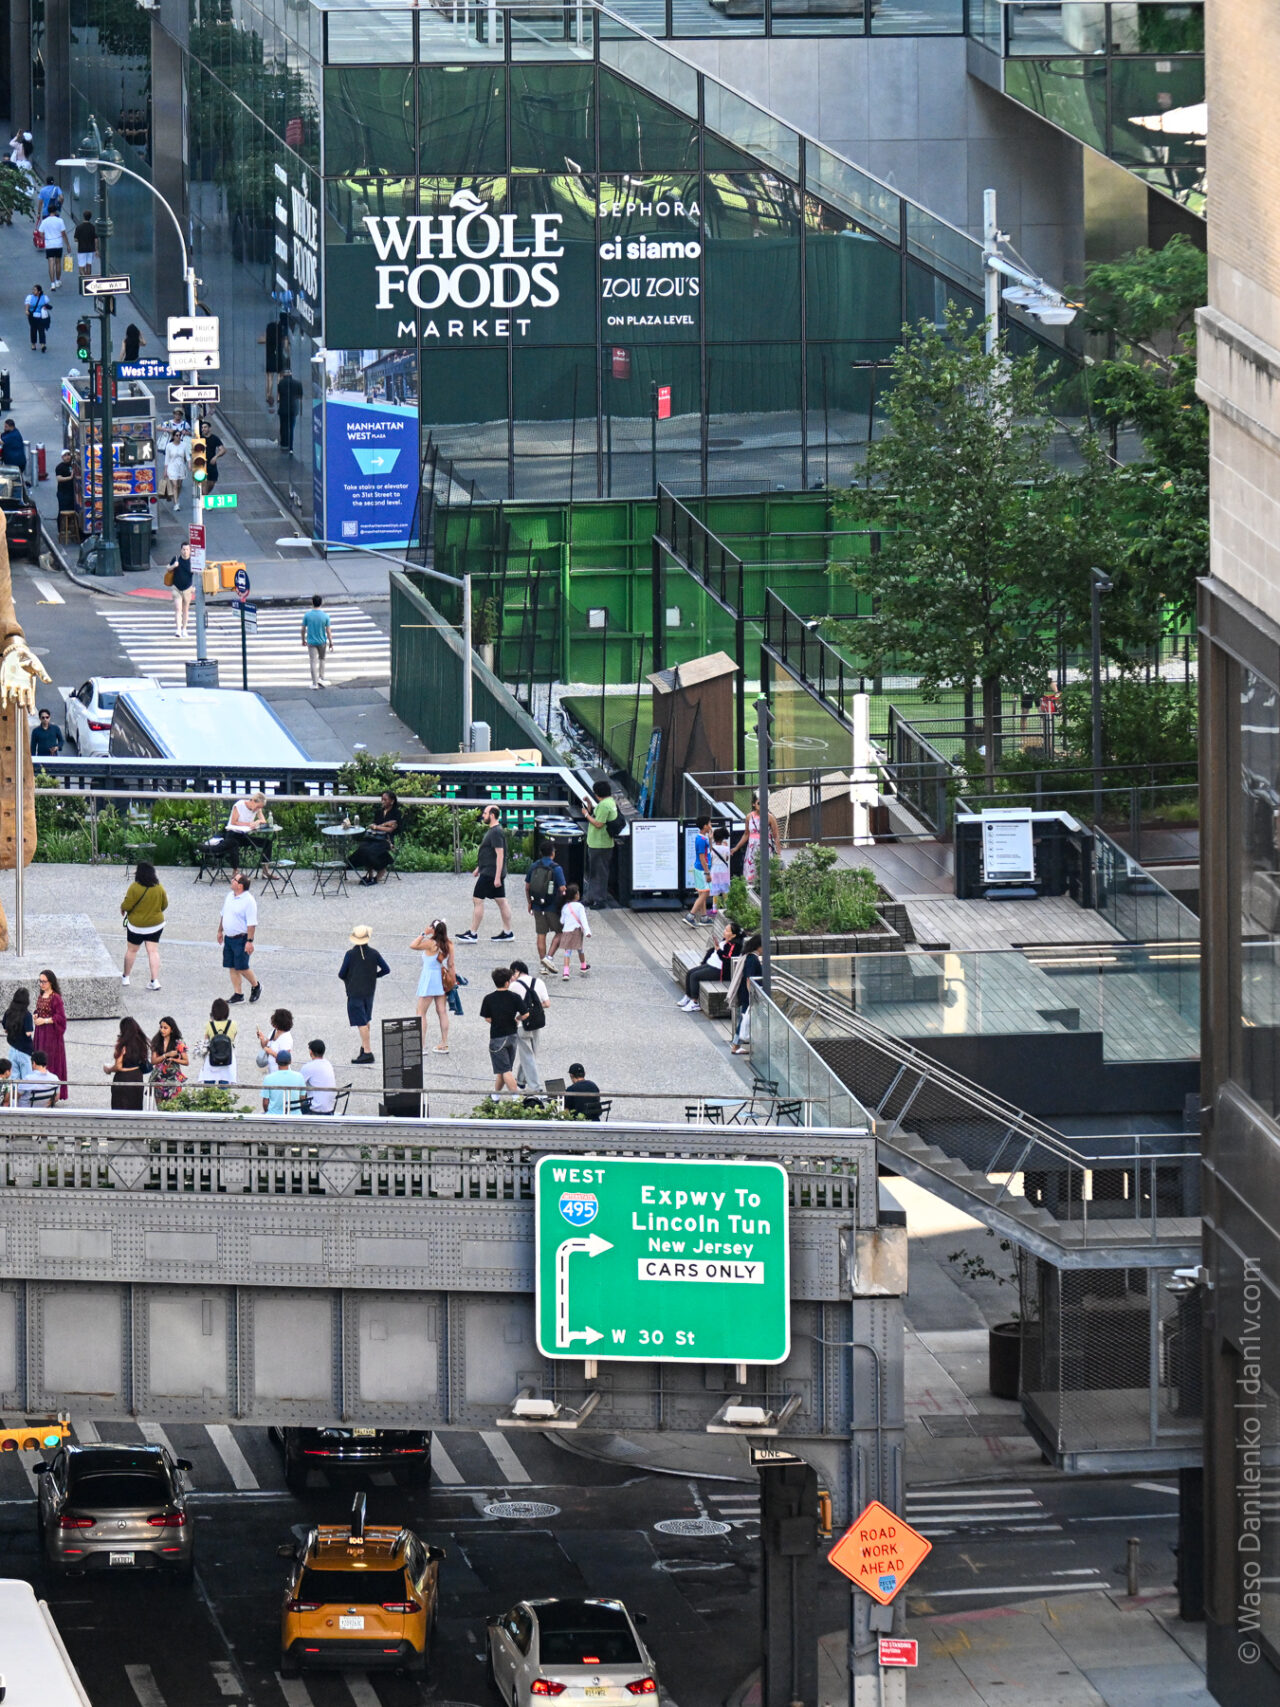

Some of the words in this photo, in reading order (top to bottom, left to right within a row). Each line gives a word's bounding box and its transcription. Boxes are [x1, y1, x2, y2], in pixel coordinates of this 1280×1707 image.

[599, 201, 701, 217] SEPHORA
[362, 212, 564, 261] WHOLE
[599, 236, 622, 260] ci
[626, 235, 701, 259] siamo
[375, 262, 560, 309] FOODS
[602, 278, 641, 297] ZOU
[646, 277, 699, 297] ZOU'S
[397, 319, 531, 338] MARKET
[607, 316, 624, 325] ON
[627, 316, 661, 325] PLAZA
[664, 315, 694, 325] LEVEL
[121, 366, 146, 376] West
[147, 366, 165, 376] 31st
[347, 422, 404, 431] MANHATTAN
[347, 432, 372, 440] WEST
[207, 496, 214, 507] W
[216, 495, 225, 506] 31
[552, 1168, 605, 1184] WEST
[641, 1186, 726, 1211] Expwy
[734, 1189, 761, 1208] To
[562, 1201, 595, 1218] 495
[632, 1212, 720, 1233] Lincoln
[728, 1215, 770, 1235] Tun
[648, 1238, 685, 1253] New
[693, 1239, 754, 1259] Jersey
[646, 1262, 698, 1277] CARS
[706, 1264, 756, 1279] ONLY
[611, 1329, 626, 1344] W
[639, 1330, 664, 1345] 30
[675, 1330, 695, 1346] St
[760, 1450, 780, 1458] ONE
[860, 1526, 897, 1542] ROAD
[861, 1543, 899, 1558] WORK
[859, 1559, 905, 1576] AHEAD
